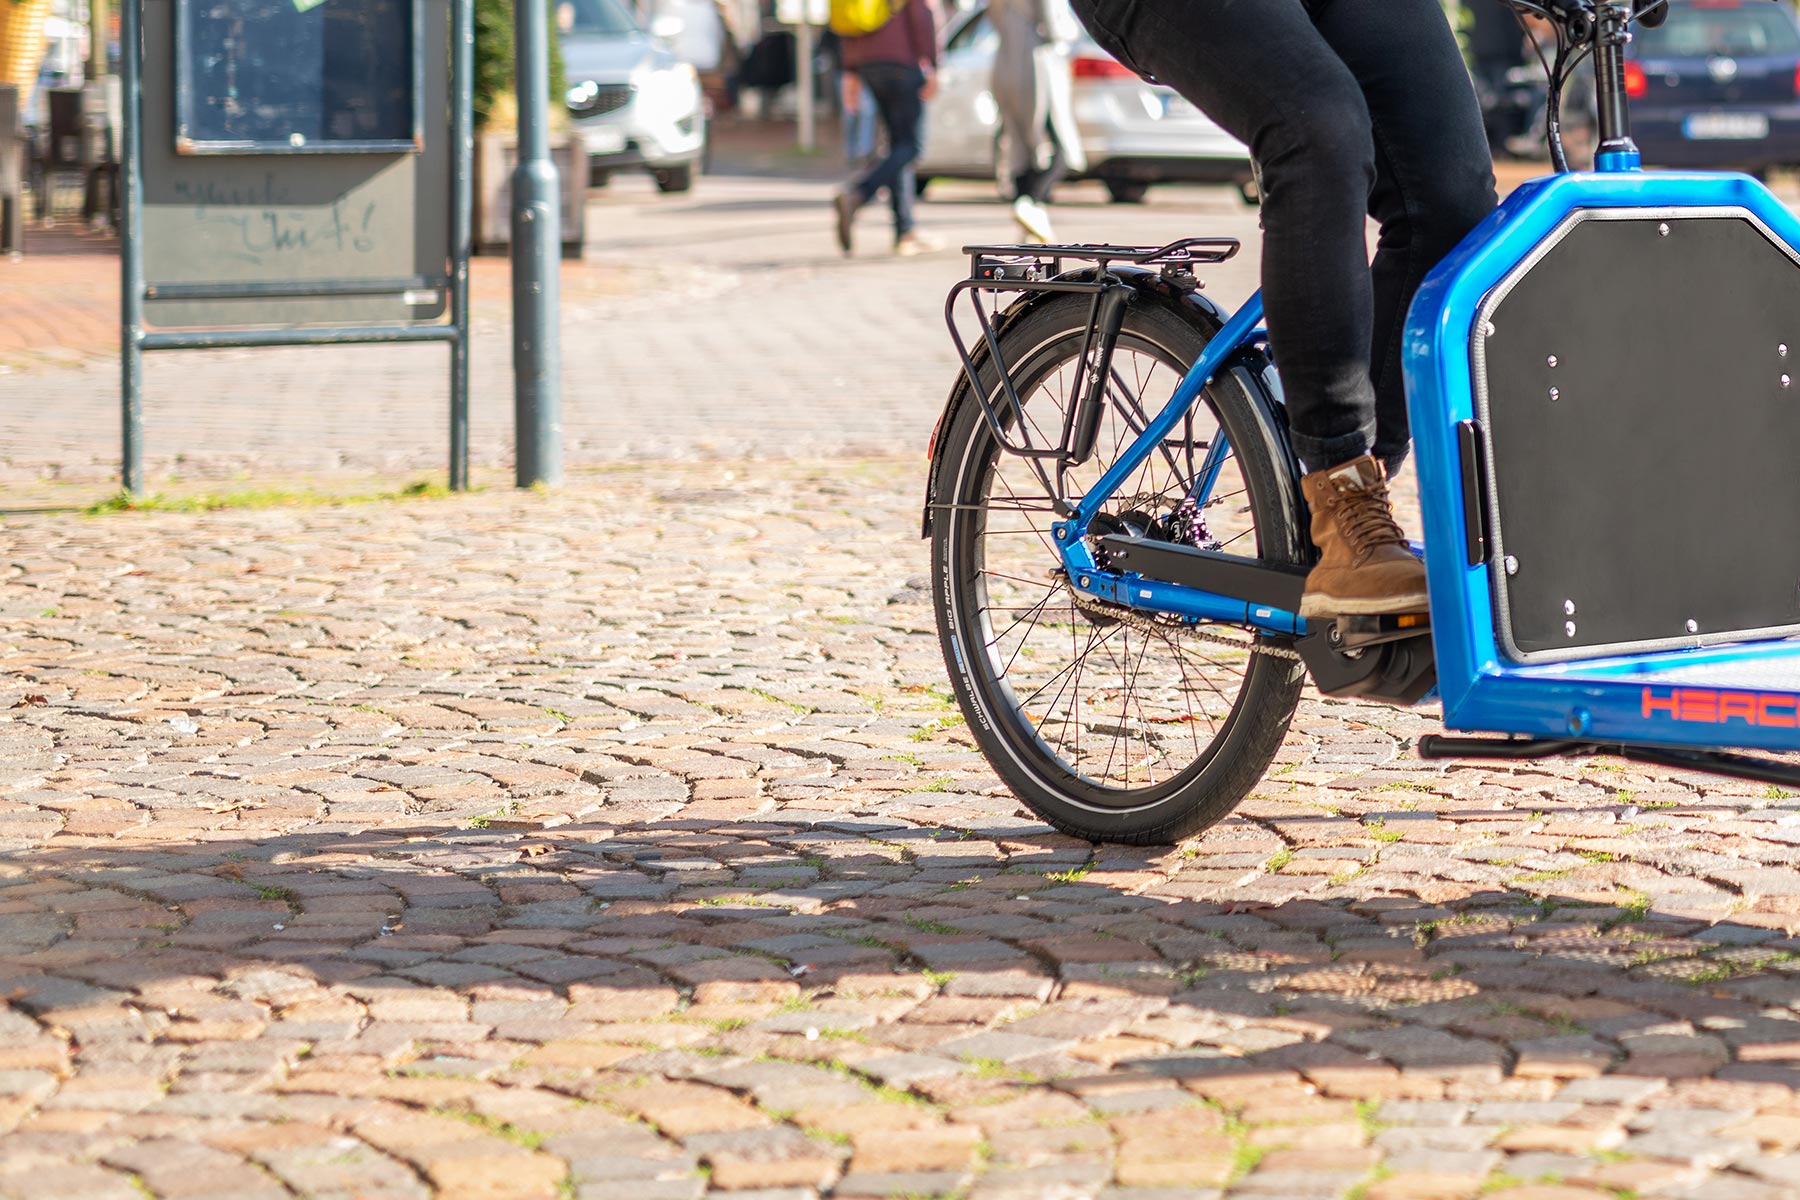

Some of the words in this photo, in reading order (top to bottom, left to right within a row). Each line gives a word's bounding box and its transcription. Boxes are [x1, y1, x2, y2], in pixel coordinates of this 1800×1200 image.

[943, 566, 951, 605] APPLE
[947, 608, 955, 630] BIG
[963, 677, 990, 731] SCHWALBE
